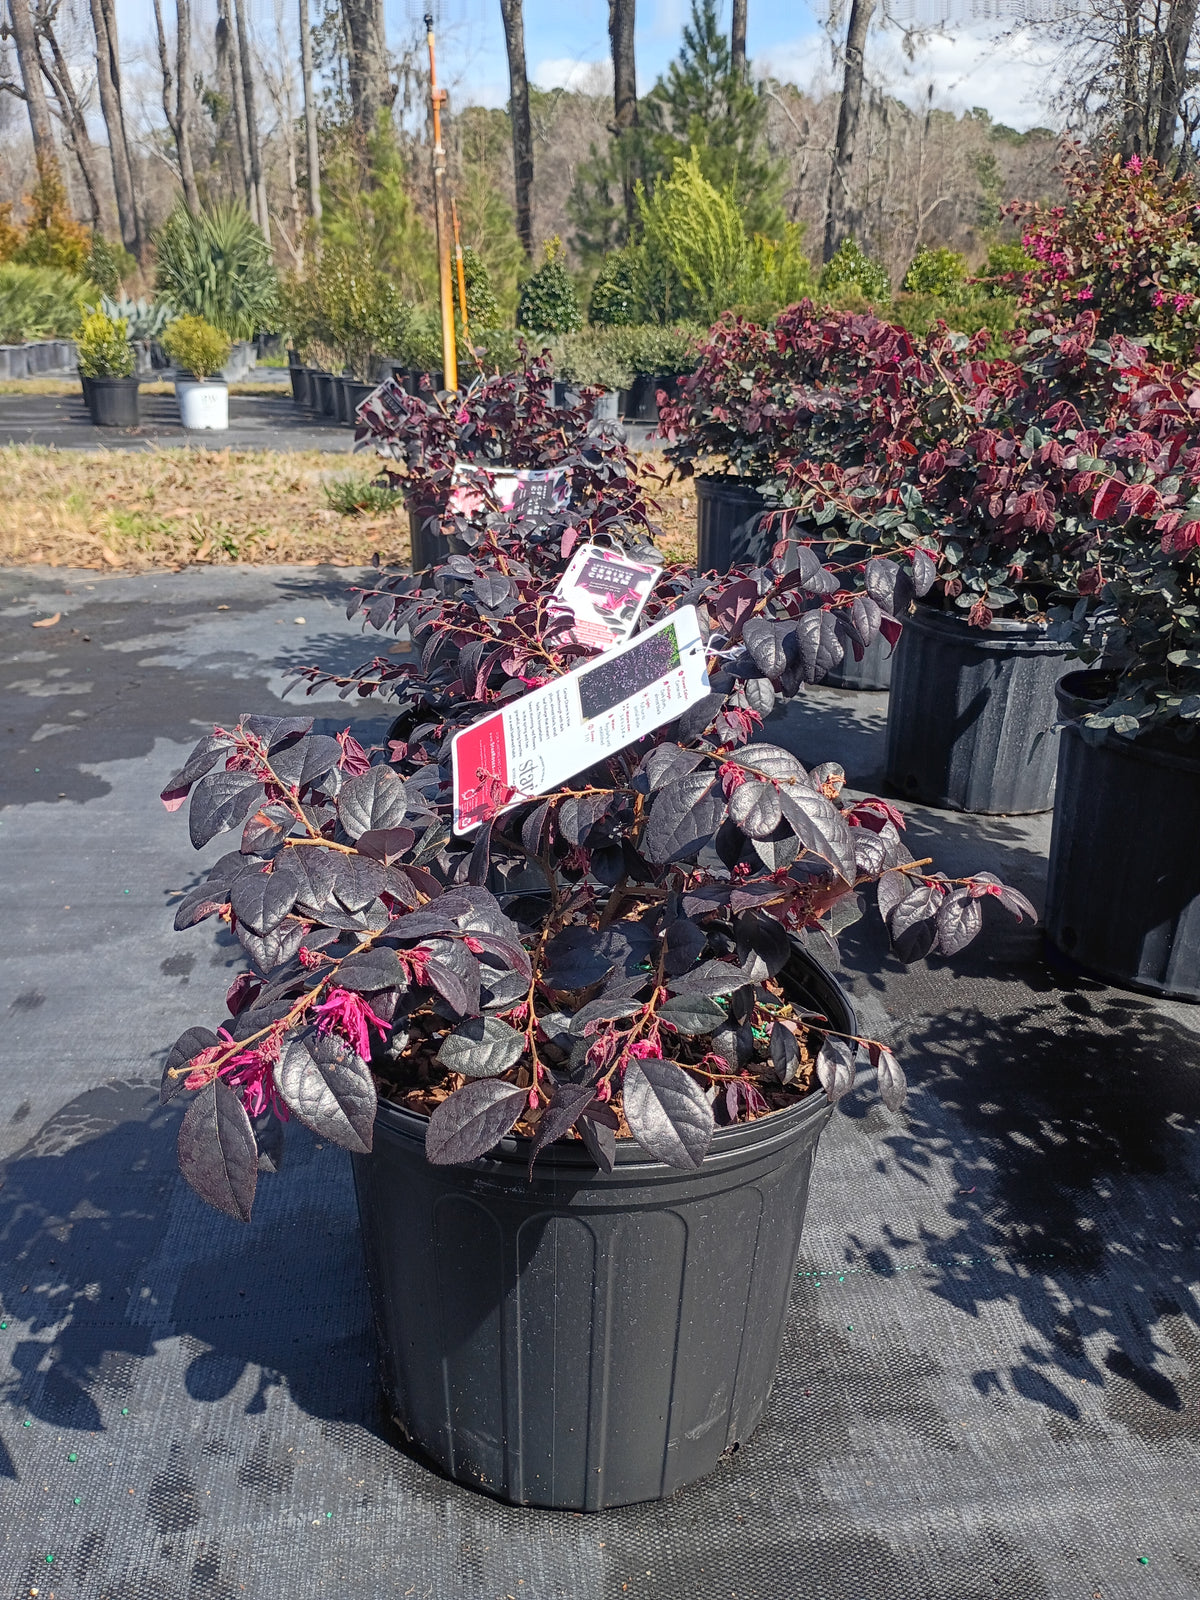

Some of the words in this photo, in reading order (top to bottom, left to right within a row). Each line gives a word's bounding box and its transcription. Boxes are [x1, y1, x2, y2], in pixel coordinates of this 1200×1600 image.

[588, 572, 629, 586] CHARM
[590, 566, 631, 581] CERISE
[518, 759, 538, 790] star
